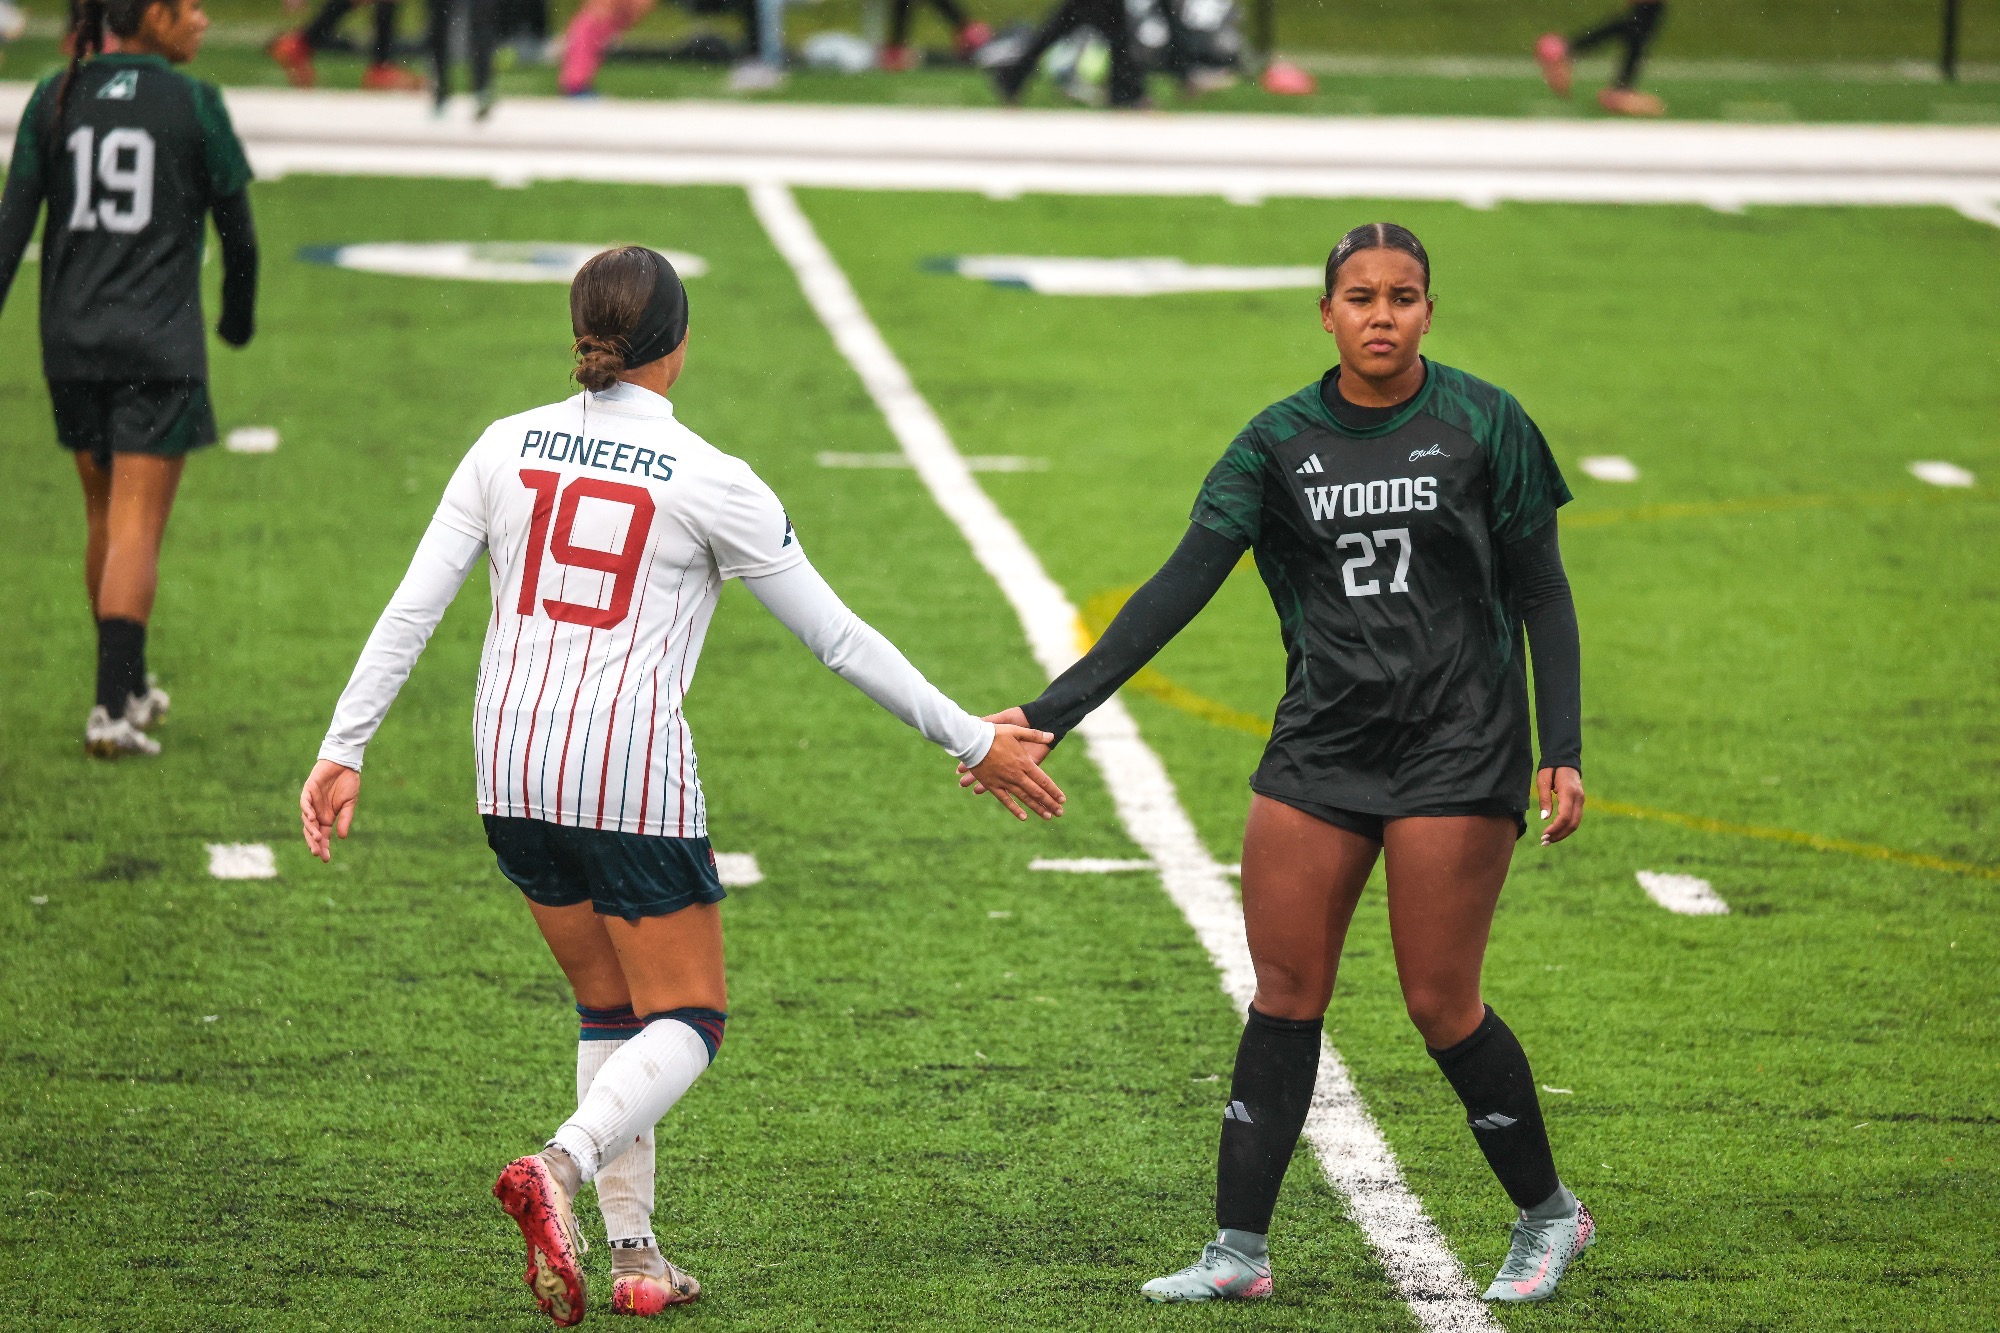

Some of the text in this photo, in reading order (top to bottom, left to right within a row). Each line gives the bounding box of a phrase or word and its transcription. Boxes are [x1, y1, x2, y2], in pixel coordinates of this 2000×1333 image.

[66, 125, 156, 234] 19
[520, 430, 677, 481] PIONEERS
[1304, 476, 1438, 521] WOODS
[517, 468, 656, 631] 19
[1336, 527, 1412, 597] 27
